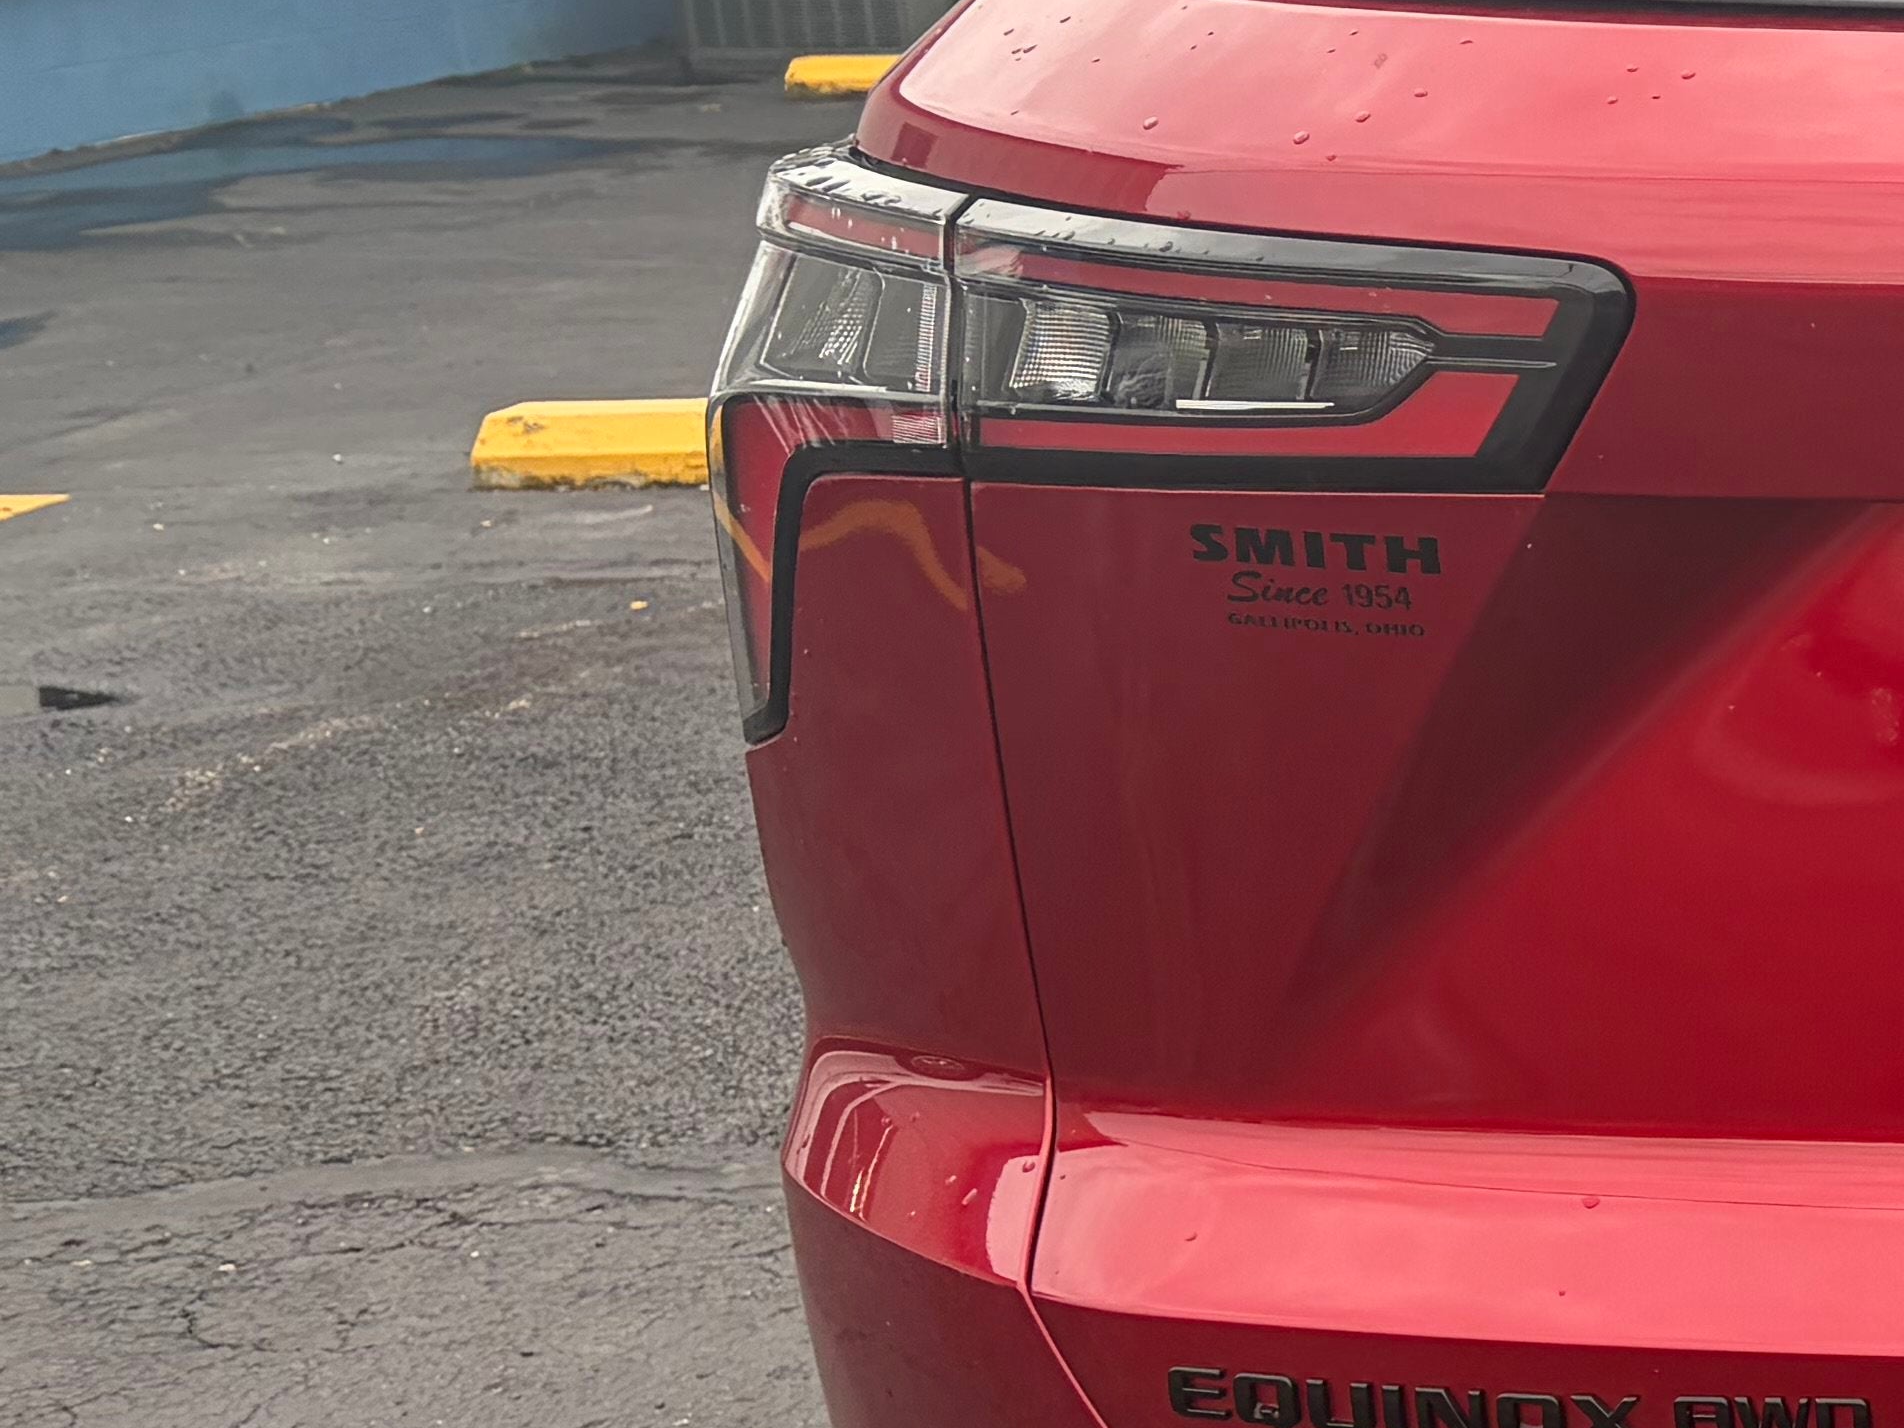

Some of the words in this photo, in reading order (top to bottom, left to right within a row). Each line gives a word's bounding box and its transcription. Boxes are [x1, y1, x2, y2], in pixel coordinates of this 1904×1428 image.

[1189, 523, 1441, 575] SMITH
[1227, 570, 1328, 606] Since
[1341, 583, 1412, 610] 1954
[1365, 622, 1424, 636] OHIO
